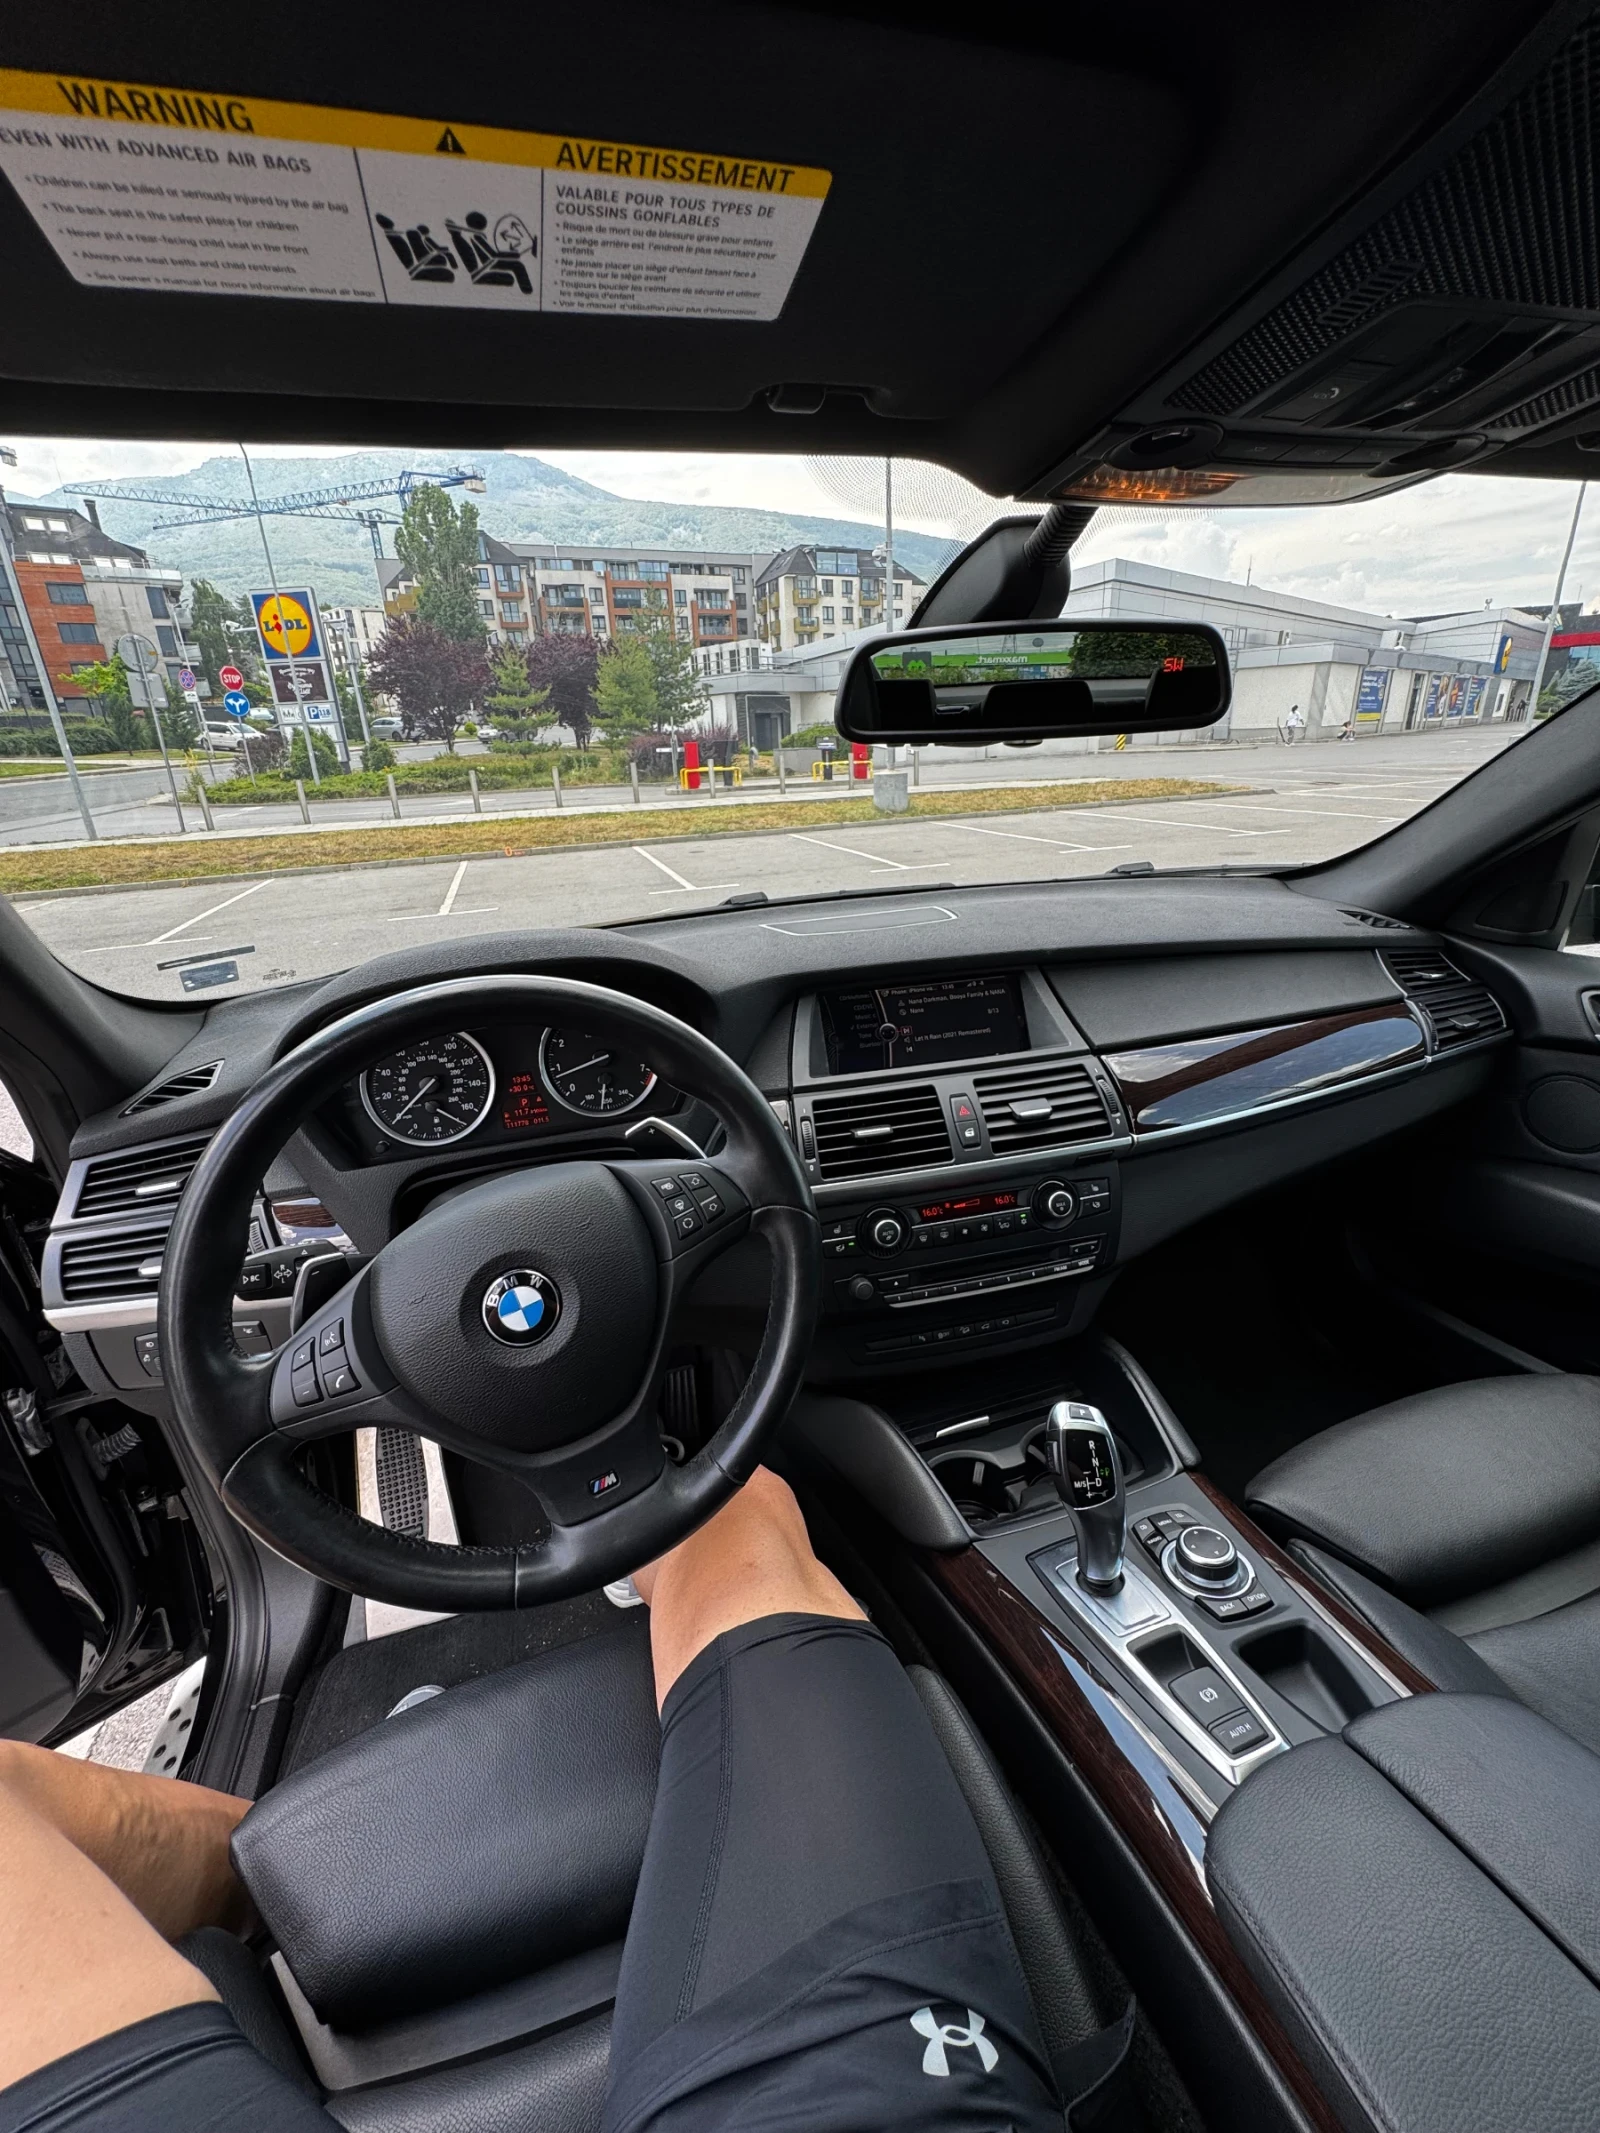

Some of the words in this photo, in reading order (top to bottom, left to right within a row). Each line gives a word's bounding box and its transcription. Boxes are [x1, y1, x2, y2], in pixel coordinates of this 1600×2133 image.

[56, 80, 254, 133] WARNING
[0, 128, 52, 147] EVEN
[56, 132, 110, 152] WITH
[117, 138, 219, 163] ADVANCED
[227, 150, 257, 168] AIR
[263, 154, 311, 172] BAGS
[556, 142, 795, 192] AVERTISSEMENT
[33, 174, 88, 188] Children
[89, 181, 111, 191] can
[112, 182, 130, 192] be
[131, 184, 164, 196] killed
[166, 189, 178, 197] or
[181, 190, 231, 203] seriously
[234, 192, 273, 205] injured
[275, 196, 289, 208] by
[291, 198, 309, 209] the
[312, 201, 325, 209] air
[328, 202, 349, 214] bag
[556, 185, 620, 203] VALABLE
[625, 191, 664, 207] POUR
[670, 196, 706, 211] TOUS
[712, 200, 752, 216] TYPES
[757, 205, 775, 219] DE
[52, 202, 75, 212] The
[108, 208, 133, 218] seat
[135, 210, 145, 218] is
[147, 211, 167, 220] the
[169, 213, 203, 223] safest
[205, 216, 235, 227] place
[238, 218, 252, 227] for
[256, 220, 299, 231] children
[555, 202, 628, 220] COUSSINS
[633, 209, 720, 228] GONFLABLES
[67, 228, 100, 238] Never
[104, 232, 123, 241] put
[200, 239, 225, 249] child
[228, 241, 250, 250] seat
[252, 243, 262, 251] in
[264, 243, 281, 252] the
[283, 245, 309, 255] front
[1163, 658, 1184, 672] SW
[223, 674, 240, 684] STOP
[444, 1042, 457, 1051] 100
[559, 1039, 565, 1047] 2
[461, 1057, 474, 1065] 120
[556, 1063, 561, 1071] 1
[640, 1064, 645, 1072] 7
[468, 1079, 481, 1087] 140
[512, 1075, 531, 1083] 13:45
[569, 1084, 576, 1092] 0
[382, 1092, 392, 1100] 20
[522, 1098, 528, 1106] P
[461, 1103, 474, 1111] 160
[250, 1274, 260, 1282] BC
[486, 1274, 543, 1308] BMW
[1089, 1440, 1096, 1449] R
[1092, 1457, 1100, 1467] N
[1074, 1480, 1087, 1488] M/S
[1095, 1478, 1102, 1487] D
[1246, 1592, 1267, 1602] OPTION
[1220, 1602, 1235, 1611] BACK
[1230, 1725, 1246, 1738] AUTO
[1244, 1722, 1252, 1731] H
